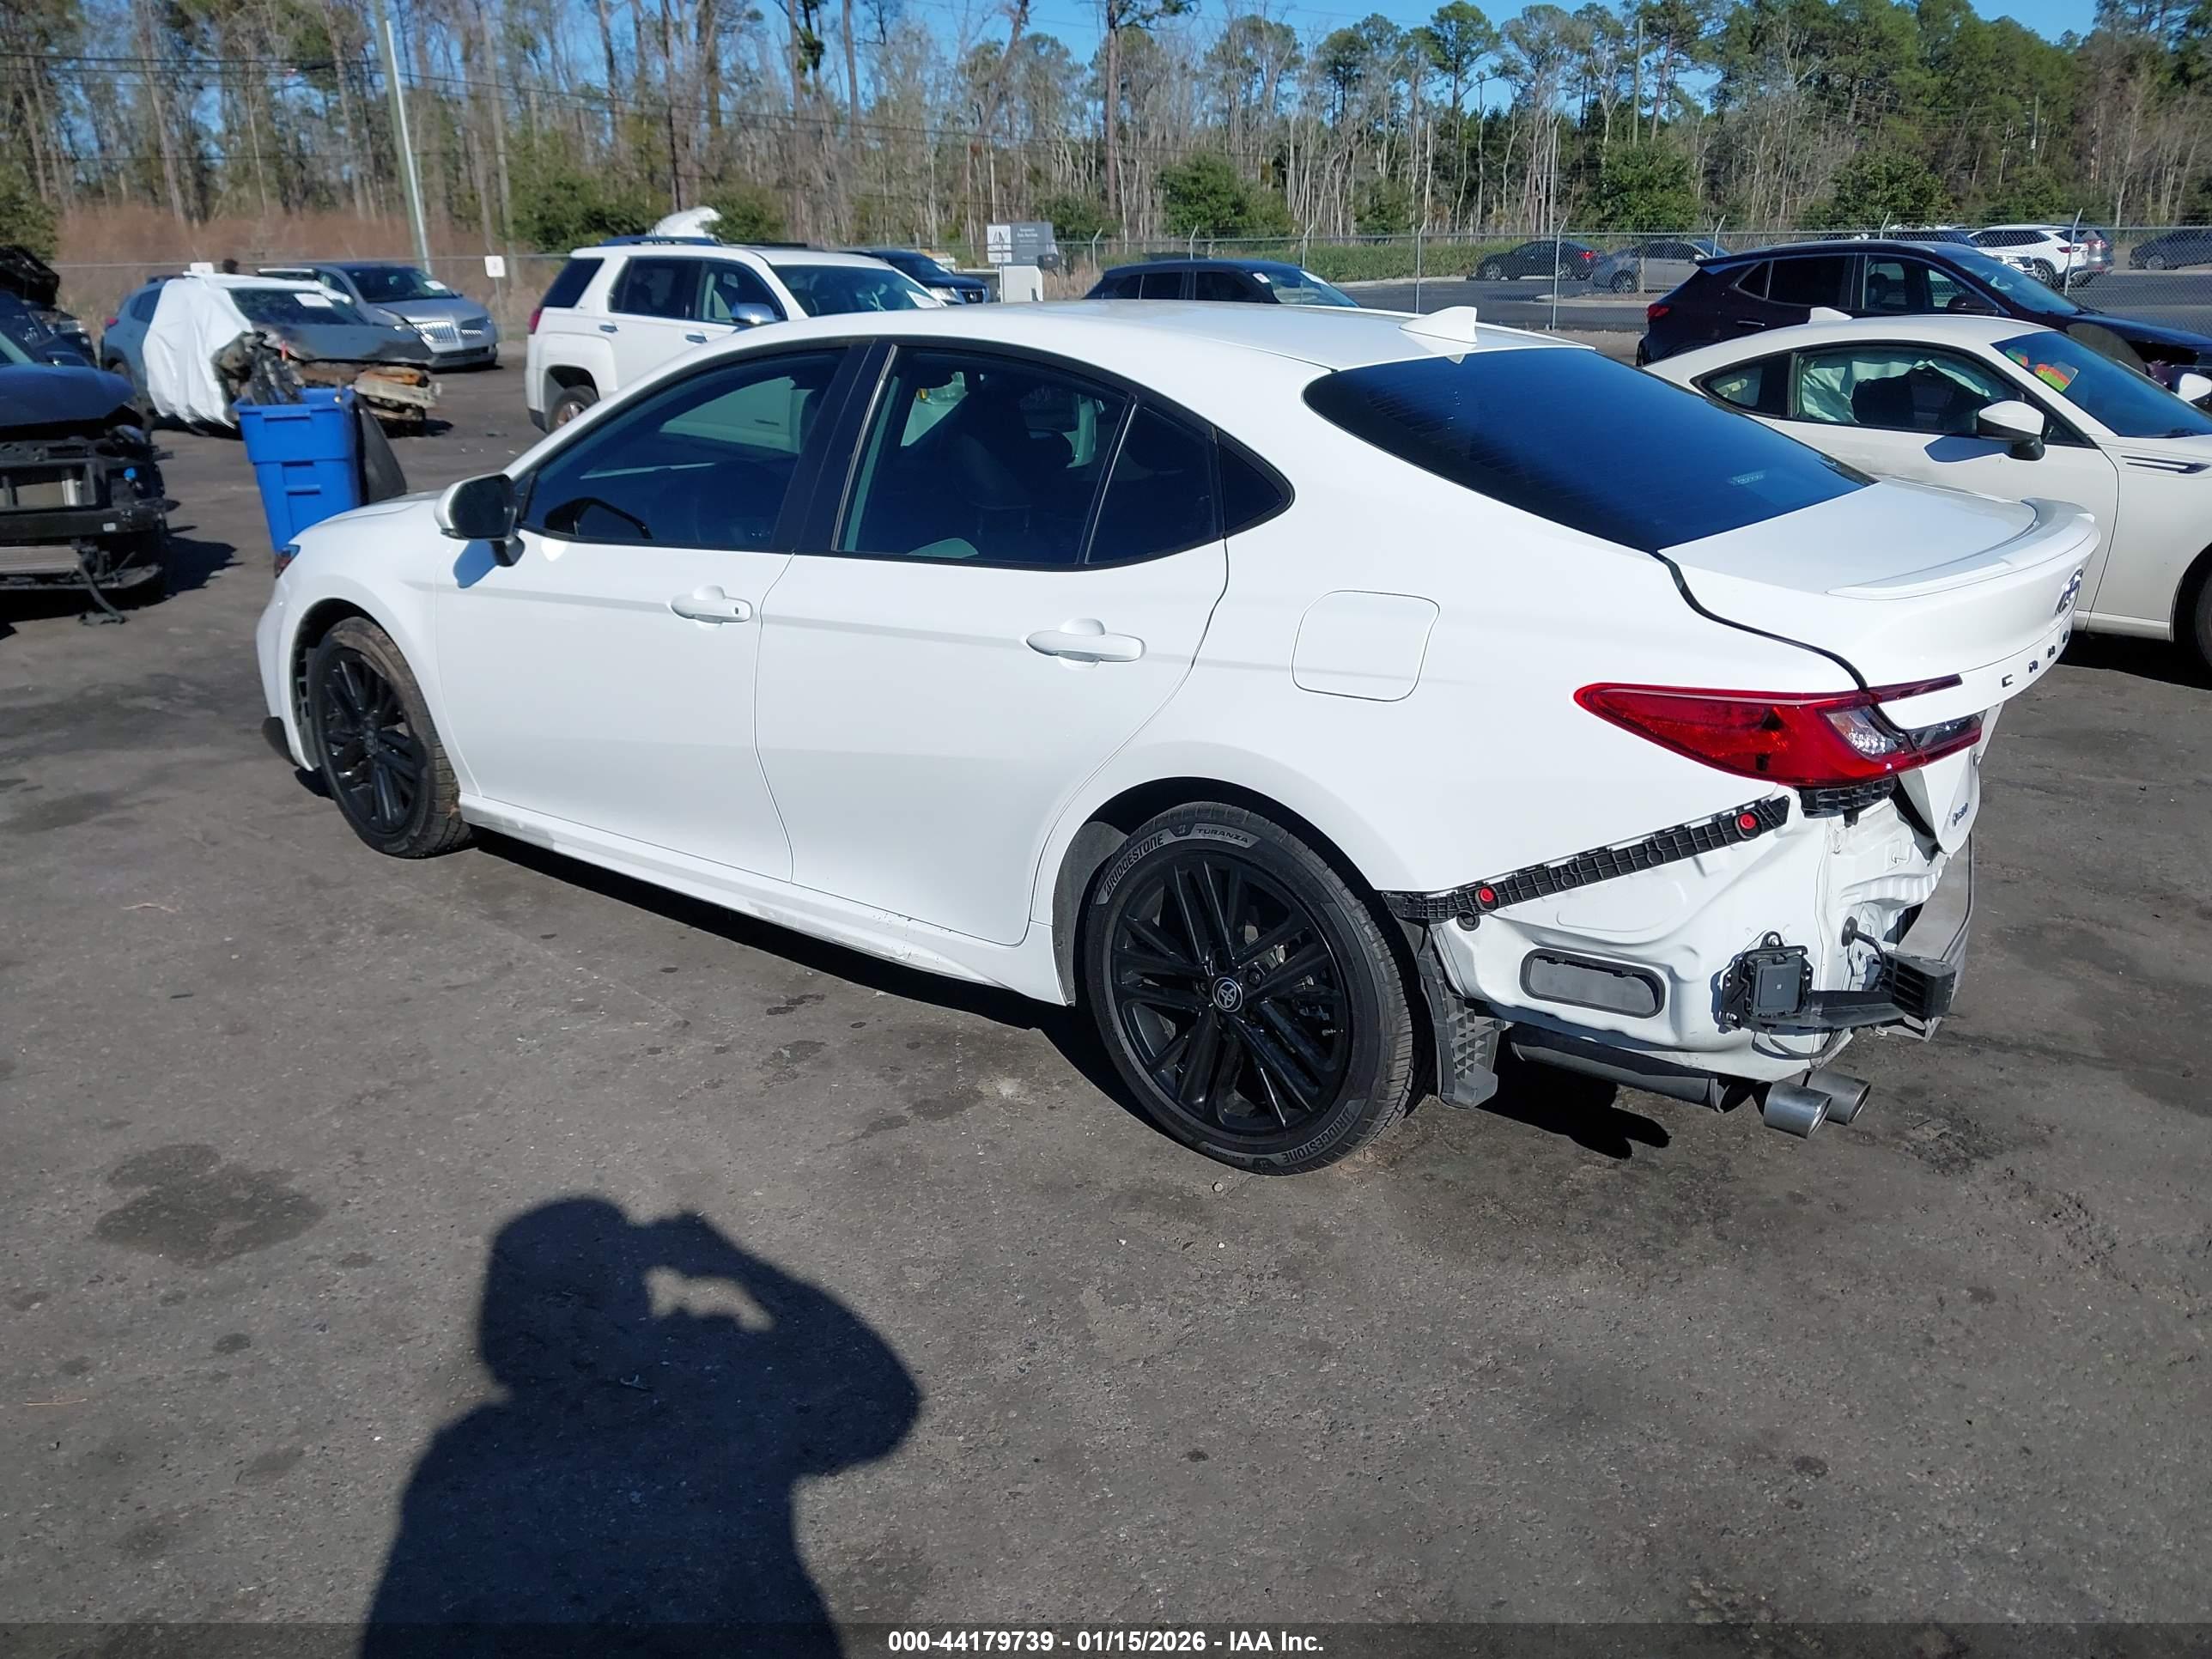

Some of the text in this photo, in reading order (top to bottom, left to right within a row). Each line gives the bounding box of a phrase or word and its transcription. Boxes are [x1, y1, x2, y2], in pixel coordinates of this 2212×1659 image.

[2001, 629, 2069, 688] CAMR
[1103, 833, 1164, 897] BRIDGESTONE
[1196, 828, 1249, 844] TURANZA
